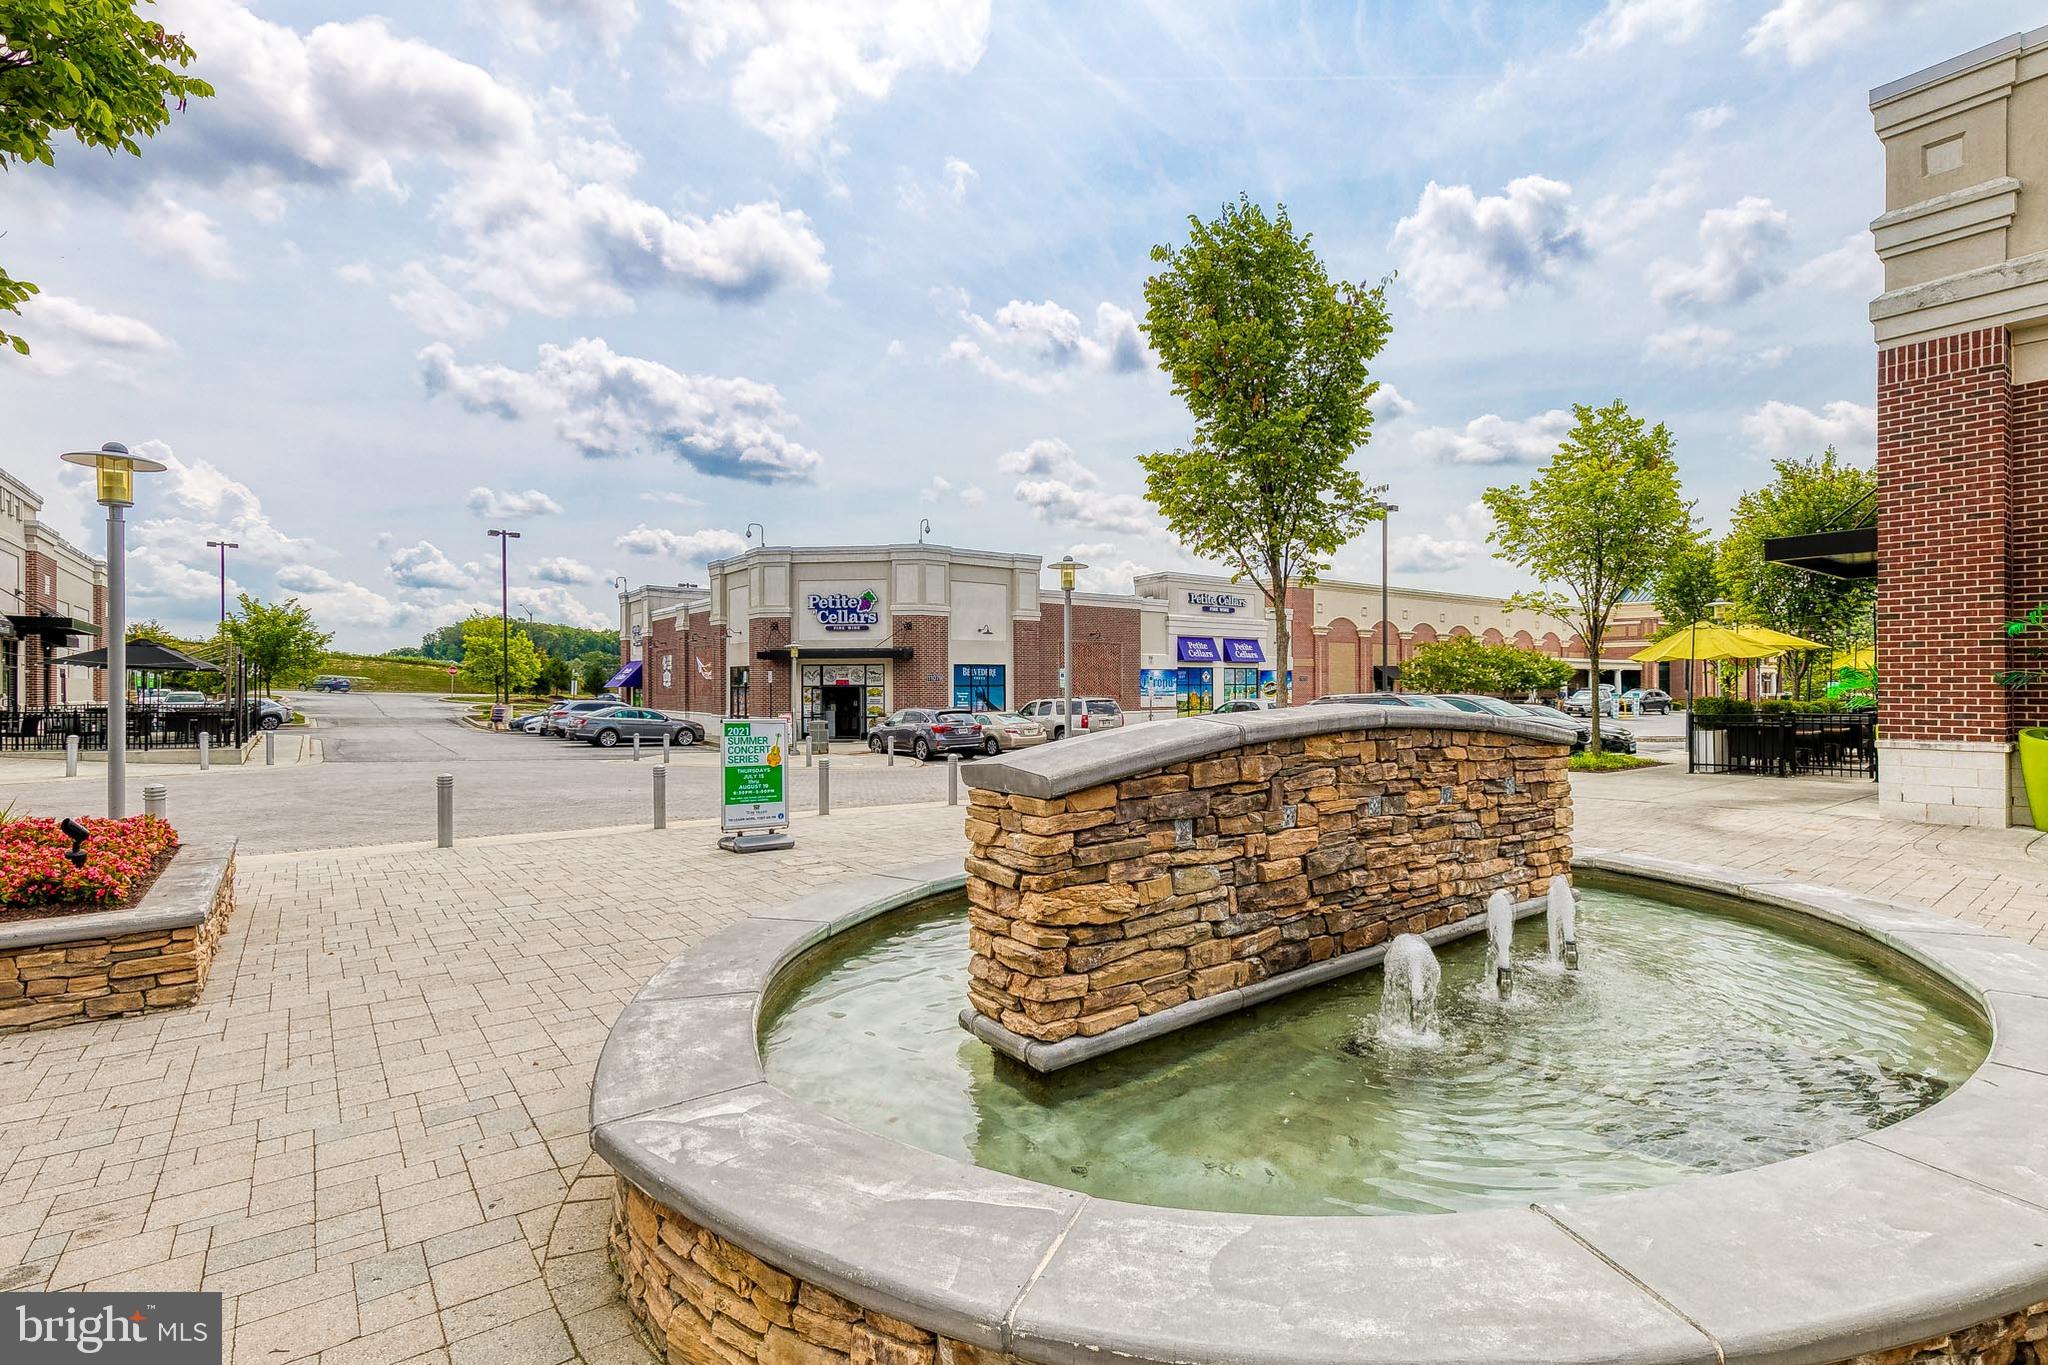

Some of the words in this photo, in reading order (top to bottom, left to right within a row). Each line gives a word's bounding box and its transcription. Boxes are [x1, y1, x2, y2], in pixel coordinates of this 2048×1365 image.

[807, 594, 858, 609] Petite
[1188, 593, 1216, 605] Petite
[1217, 595, 1247, 607] Cellars
[817, 609, 878, 624] Cellars
[1187, 641, 1208, 650] Petite
[1233, 643, 1253, 651] Petite
[1188, 649, 1214, 658] Cellars
[1234, 650, 1259, 659] Cellars
[728, 728, 749, 736] 2021
[728, 736, 768, 745] SUMMER
[728, 746, 770, 754] CONCERT
[728, 754, 760, 764] SERIES
